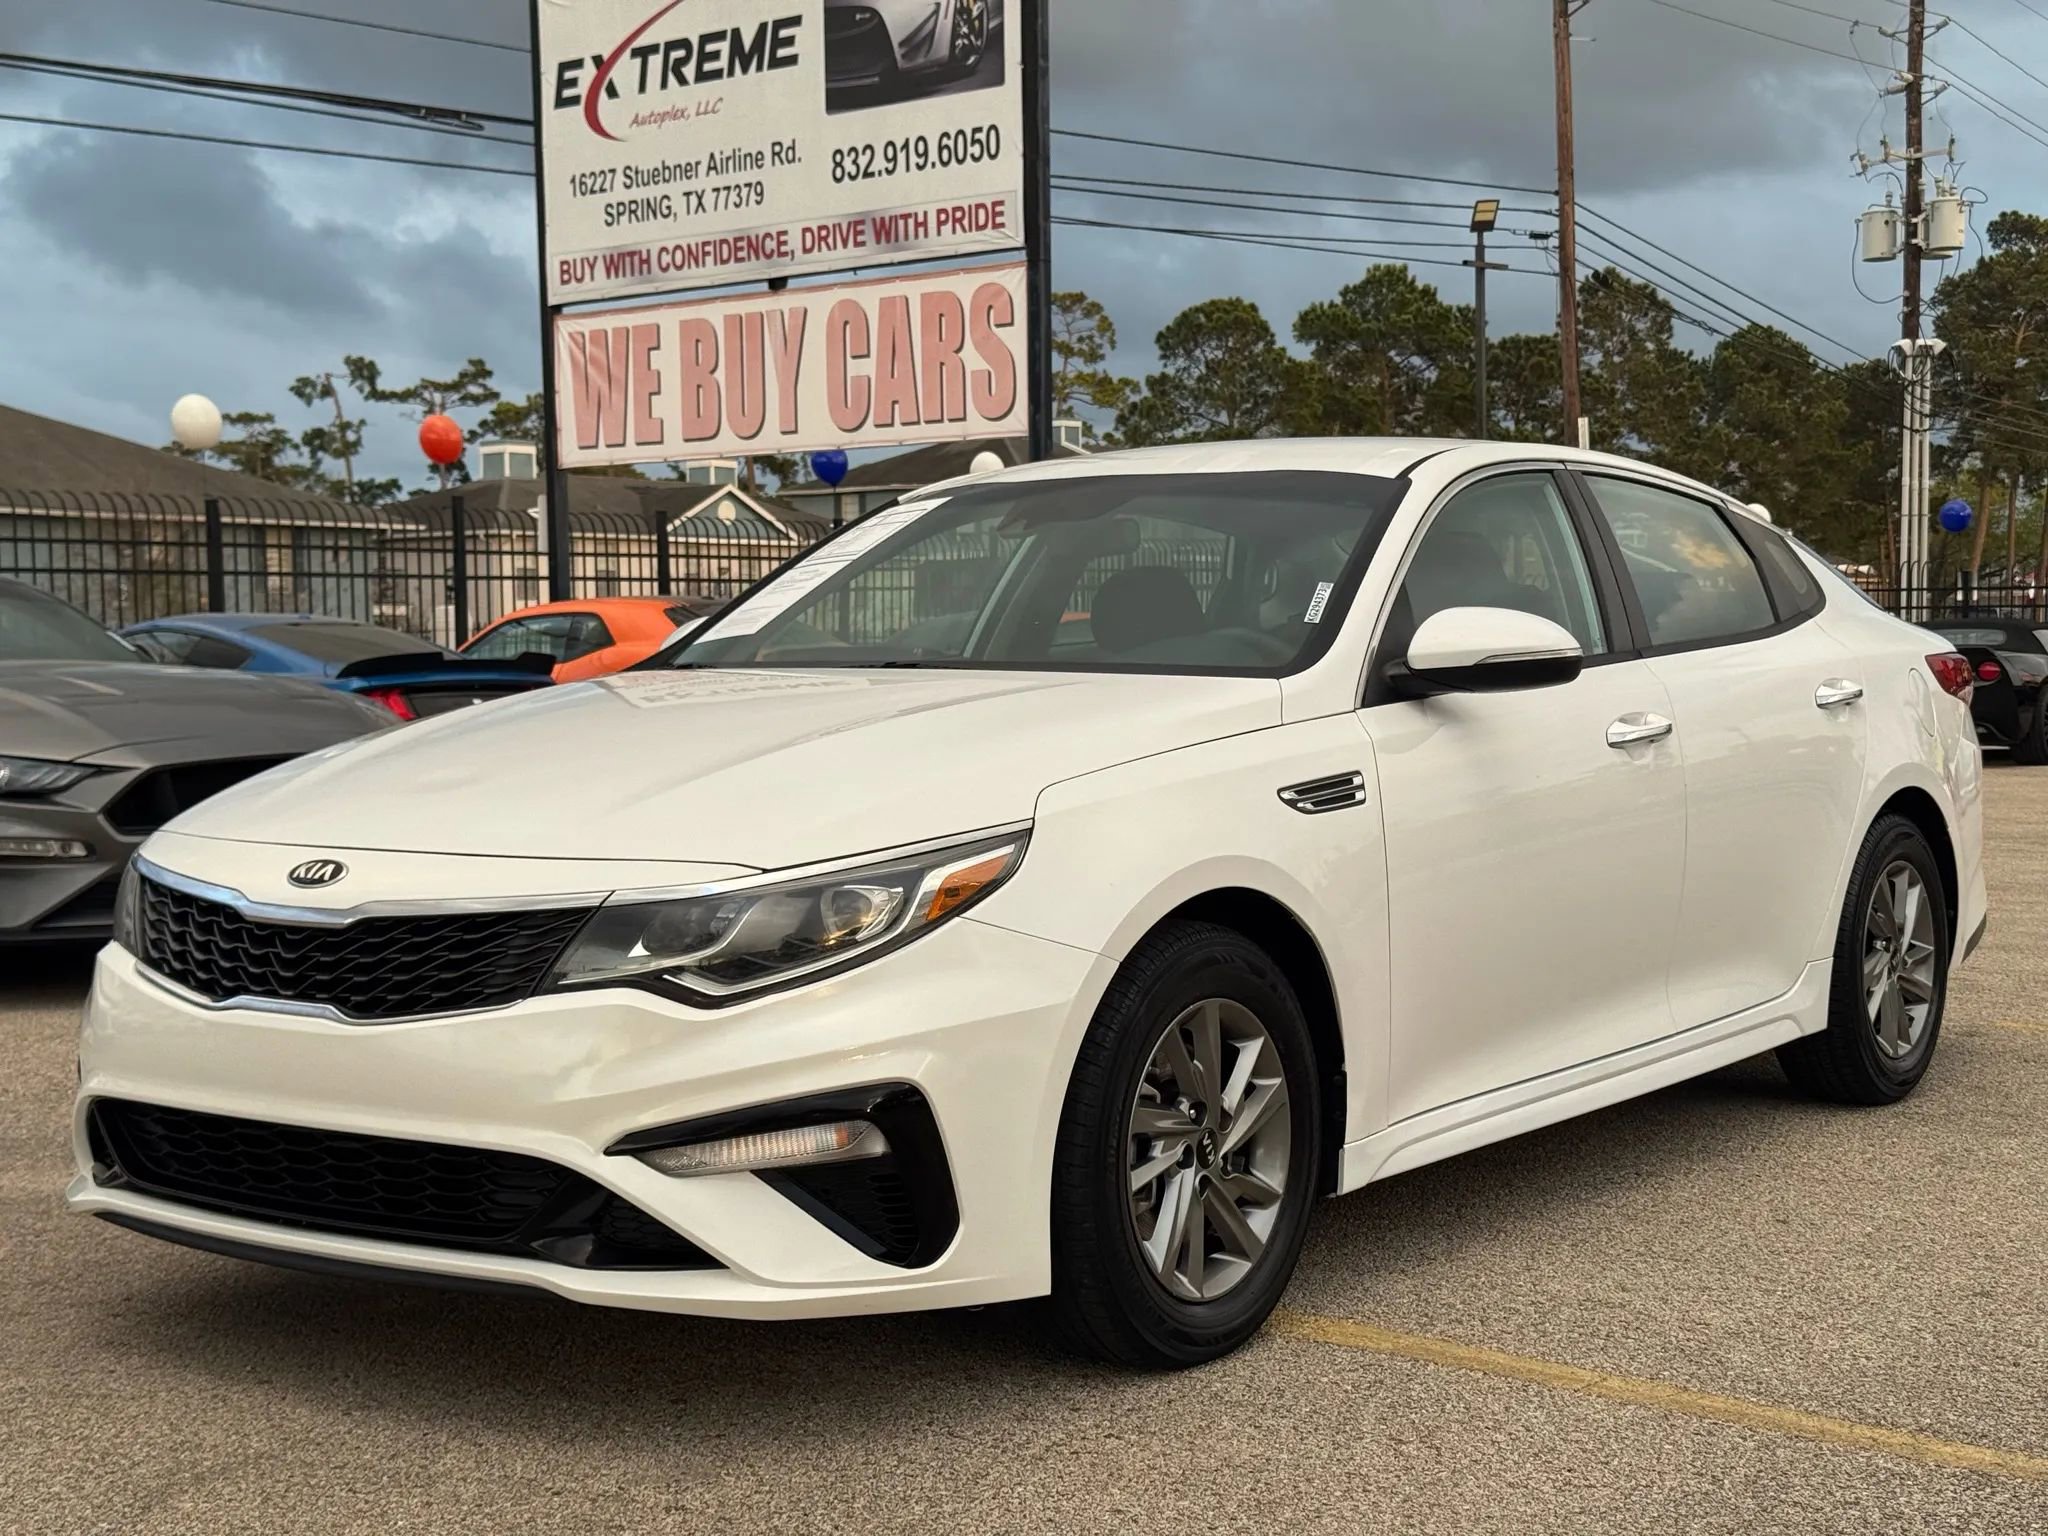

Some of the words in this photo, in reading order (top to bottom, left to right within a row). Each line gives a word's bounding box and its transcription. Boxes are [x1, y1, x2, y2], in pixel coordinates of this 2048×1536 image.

[554, 14, 803, 110] EXTREME
[628, 104, 690, 128] Autoplex,
[695, 97, 724, 117] LLC
[569, 167, 617, 198] 16227
[622, 160, 701, 191] Stuebner
[706, 147, 766, 177] Airline
[770, 138, 803, 167] Rd.
[831, 123, 1002, 184] 832.919.6050
[603, 194, 678, 227] SPRING,
[682, 189, 707, 216] TX
[711, 180, 765, 212] 77379
[559, 255, 599, 286] BUY
[603, 247, 652, 279] WITH
[656, 230, 796, 273] CONFIDENCE,
[801, 218, 867, 256] DRIVE
[872, 209, 931, 246] WITH
[935, 199, 1007, 237] PRIDE
[568, 323, 664, 450] WE
[678, 306, 808, 442] BUY
[825, 282, 1017, 432] CARS
[292, 862, 336, 881] KIA
